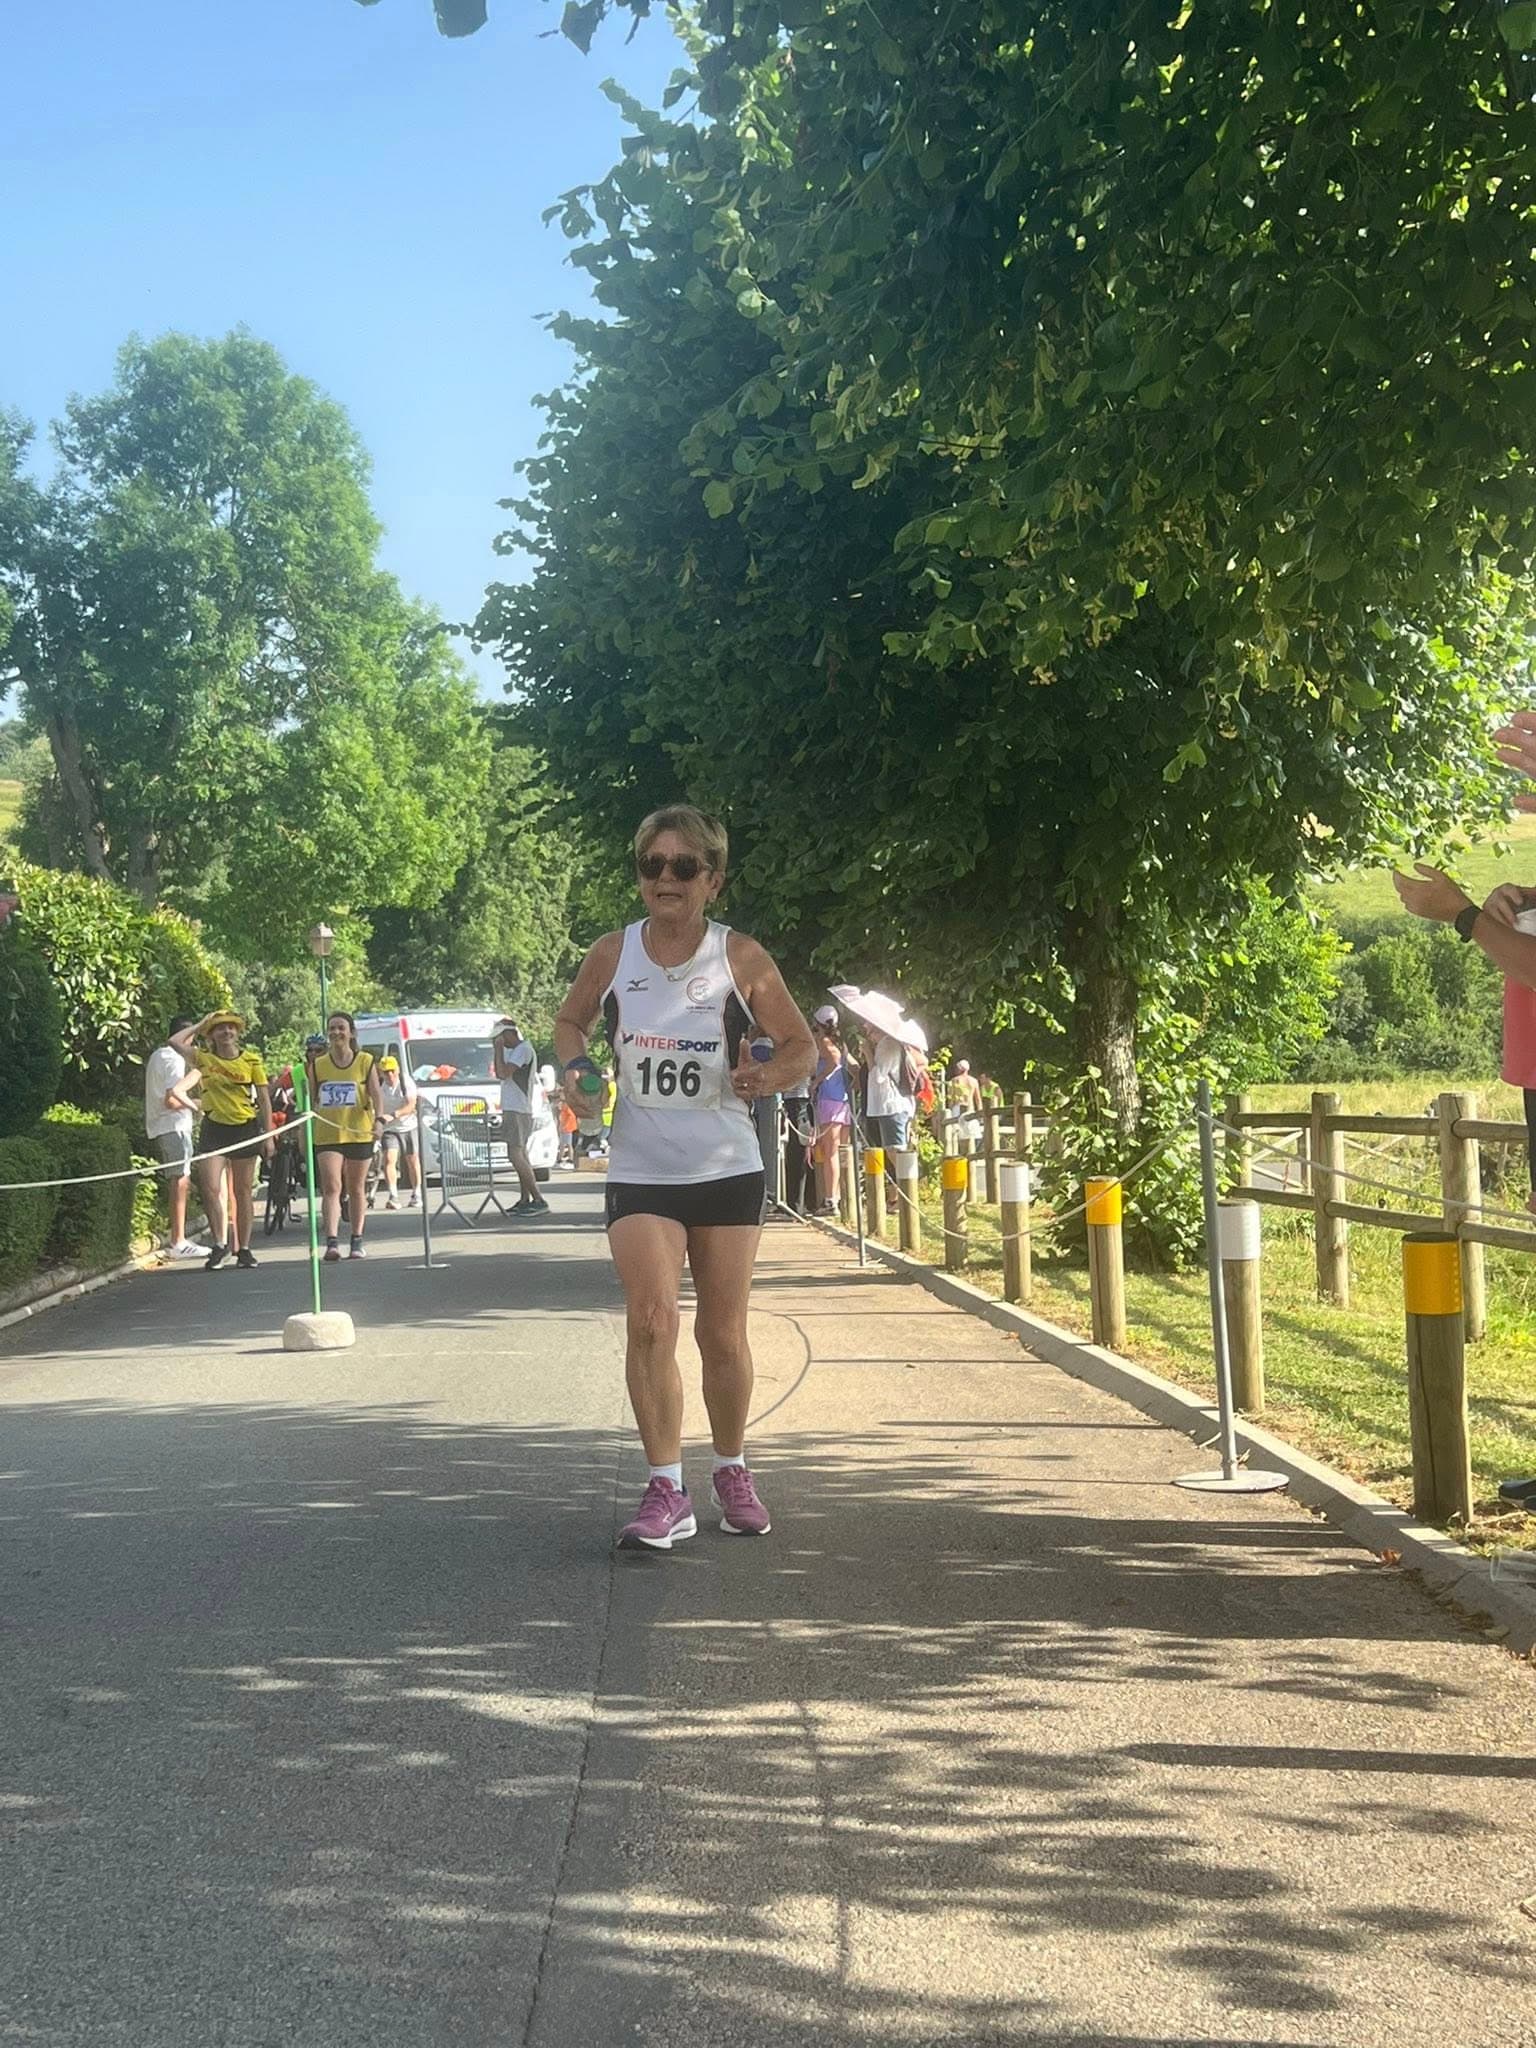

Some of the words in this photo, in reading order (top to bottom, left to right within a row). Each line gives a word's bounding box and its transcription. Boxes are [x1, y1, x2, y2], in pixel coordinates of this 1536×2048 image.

[635, 1035, 719, 1052] INTERSPORT
[637, 1057, 701, 1097] 166
[328, 1090, 349, 1104] 357
